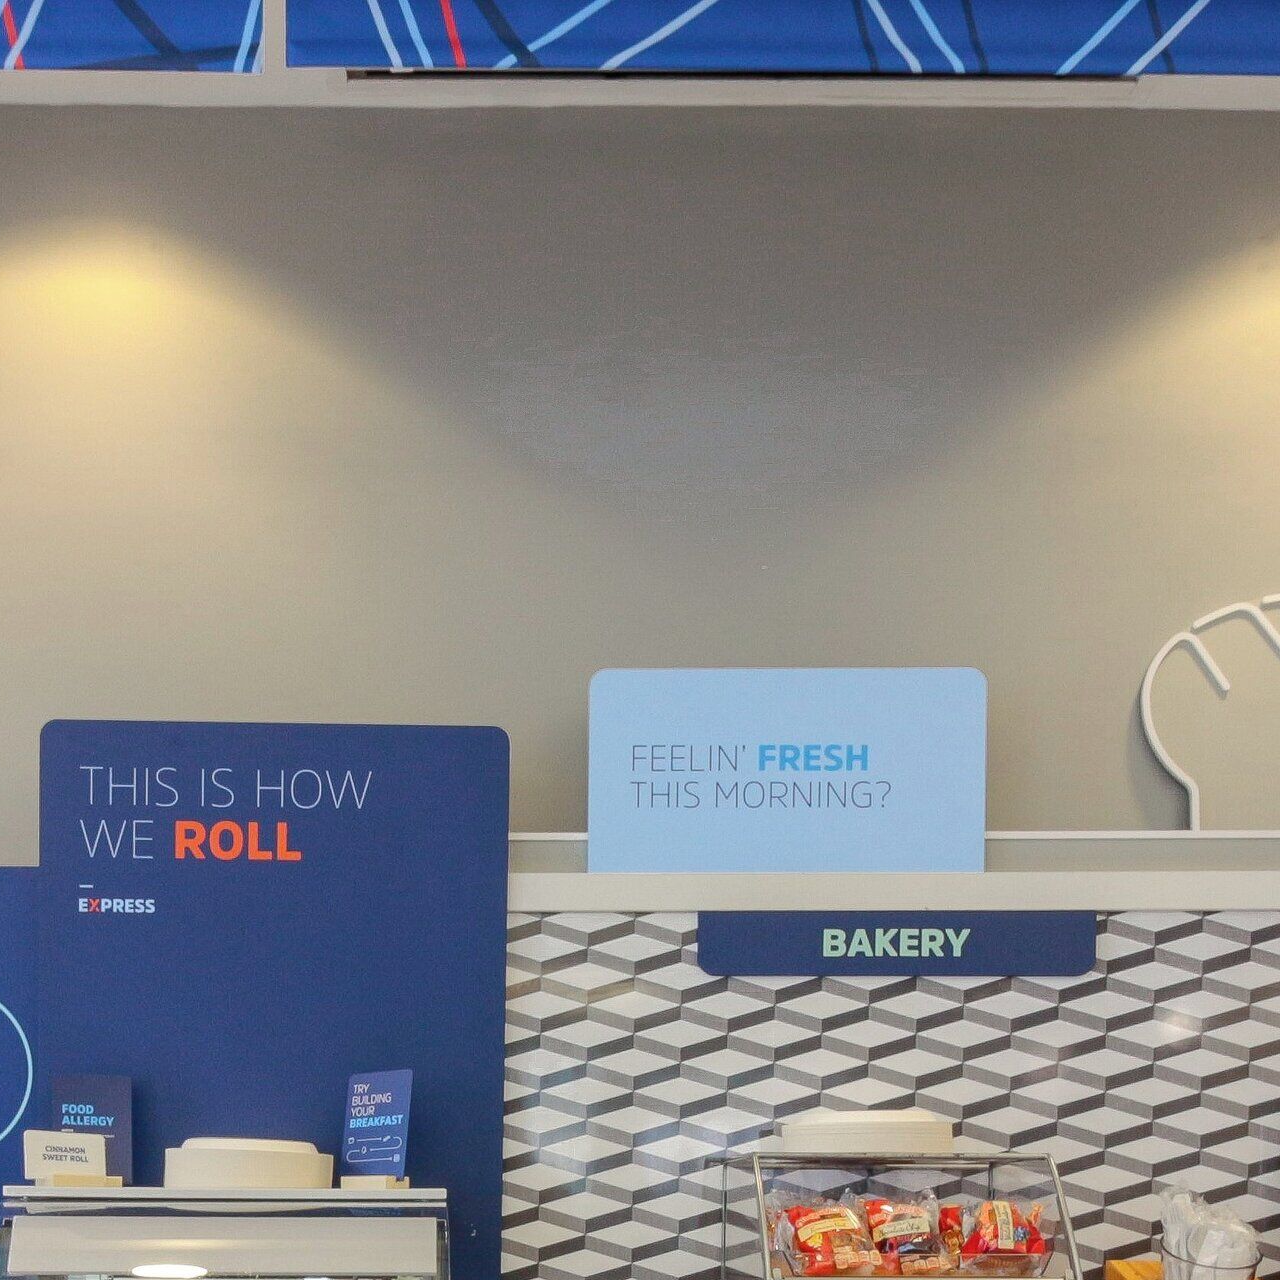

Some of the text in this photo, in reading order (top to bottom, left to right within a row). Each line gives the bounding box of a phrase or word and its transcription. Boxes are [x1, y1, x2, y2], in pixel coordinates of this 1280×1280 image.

[631, 743, 869, 773] FEELIN' FRESH
[79, 765, 373, 810] THIS IS HOW
[629, 780, 892, 809] THIS MORNING?
[79, 819, 302, 861] WE ROLL
[78, 897, 156, 914] EXPRESS
[822, 927, 971, 958] BAKERY
[353, 1083, 370, 1094] TRY
[351, 1092, 392, 1106] BUILDING
[61, 1104, 94, 1114] FOOD
[351, 1105, 375, 1117] YOUR
[61, 1115, 114, 1126] ALLERGY
[349, 1115, 403, 1128] BREAKFAST
